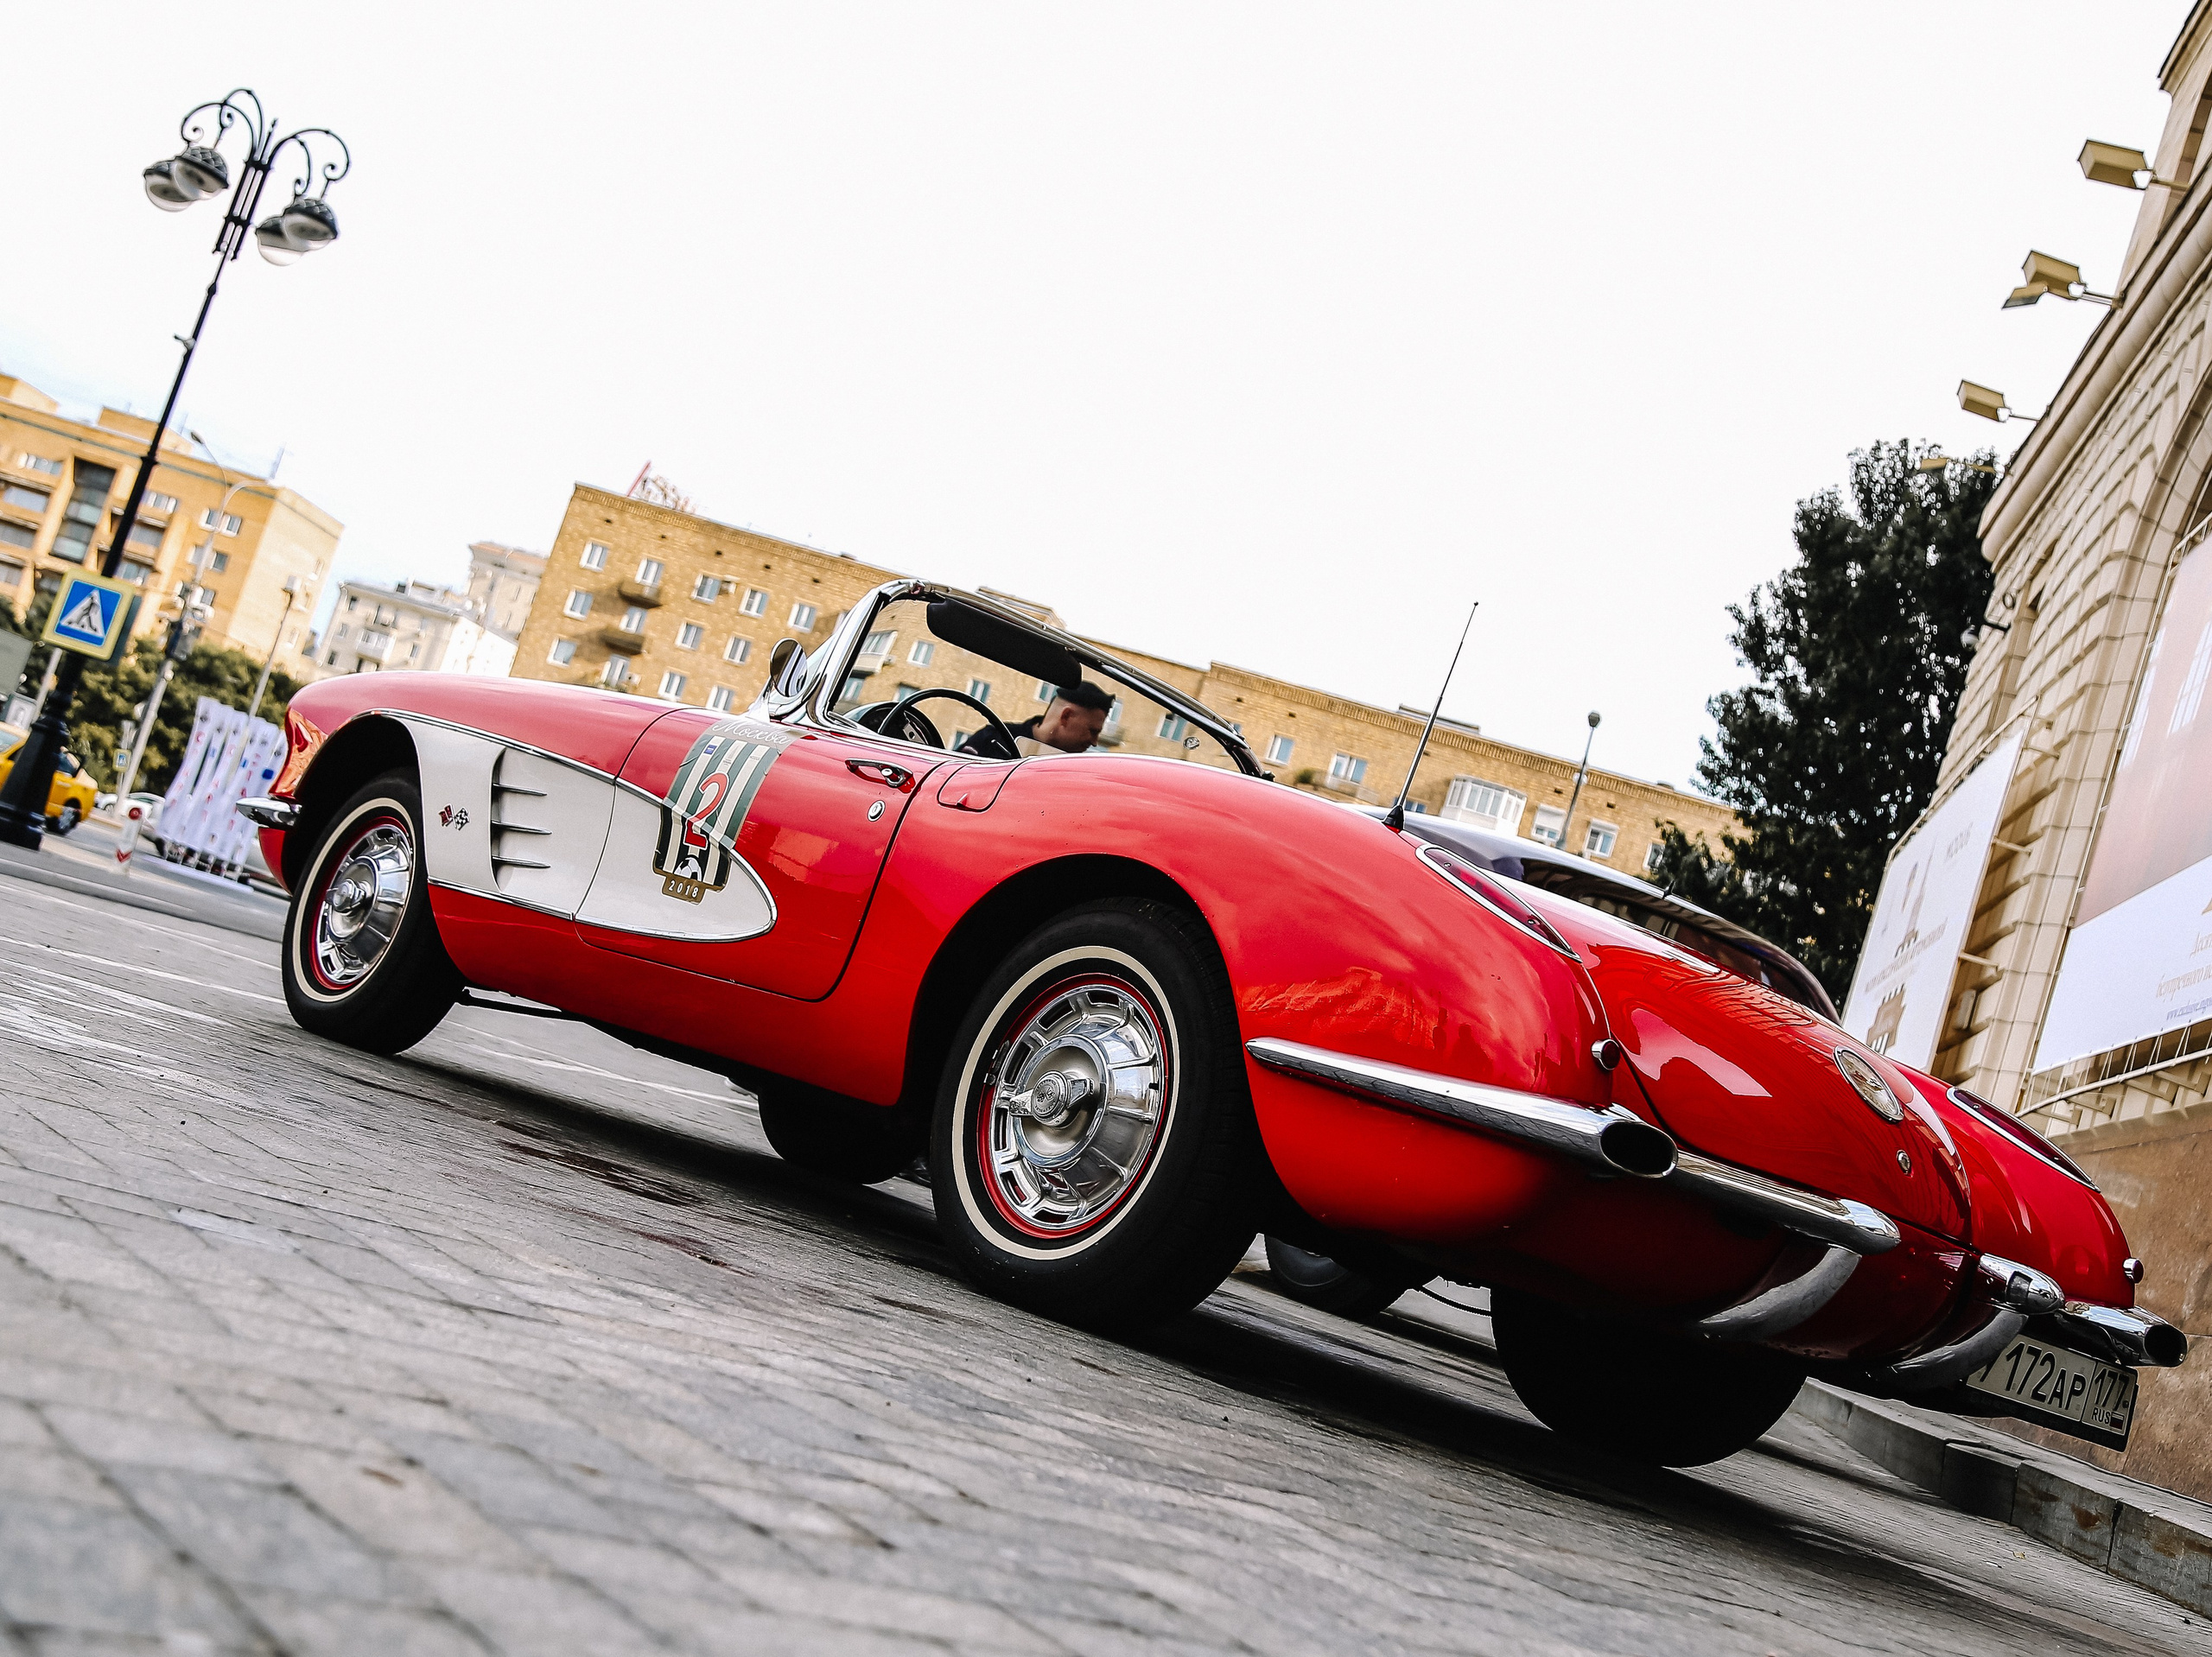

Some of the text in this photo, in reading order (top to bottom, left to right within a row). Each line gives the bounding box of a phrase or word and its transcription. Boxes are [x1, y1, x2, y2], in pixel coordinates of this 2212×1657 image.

[712, 721, 792, 745] Москва
[683, 771, 729, 850] 2
[668, 879, 700, 898] 2018
[2094, 1367, 2130, 1412] 177
[2091, 1406, 2111, 1425] RUS
